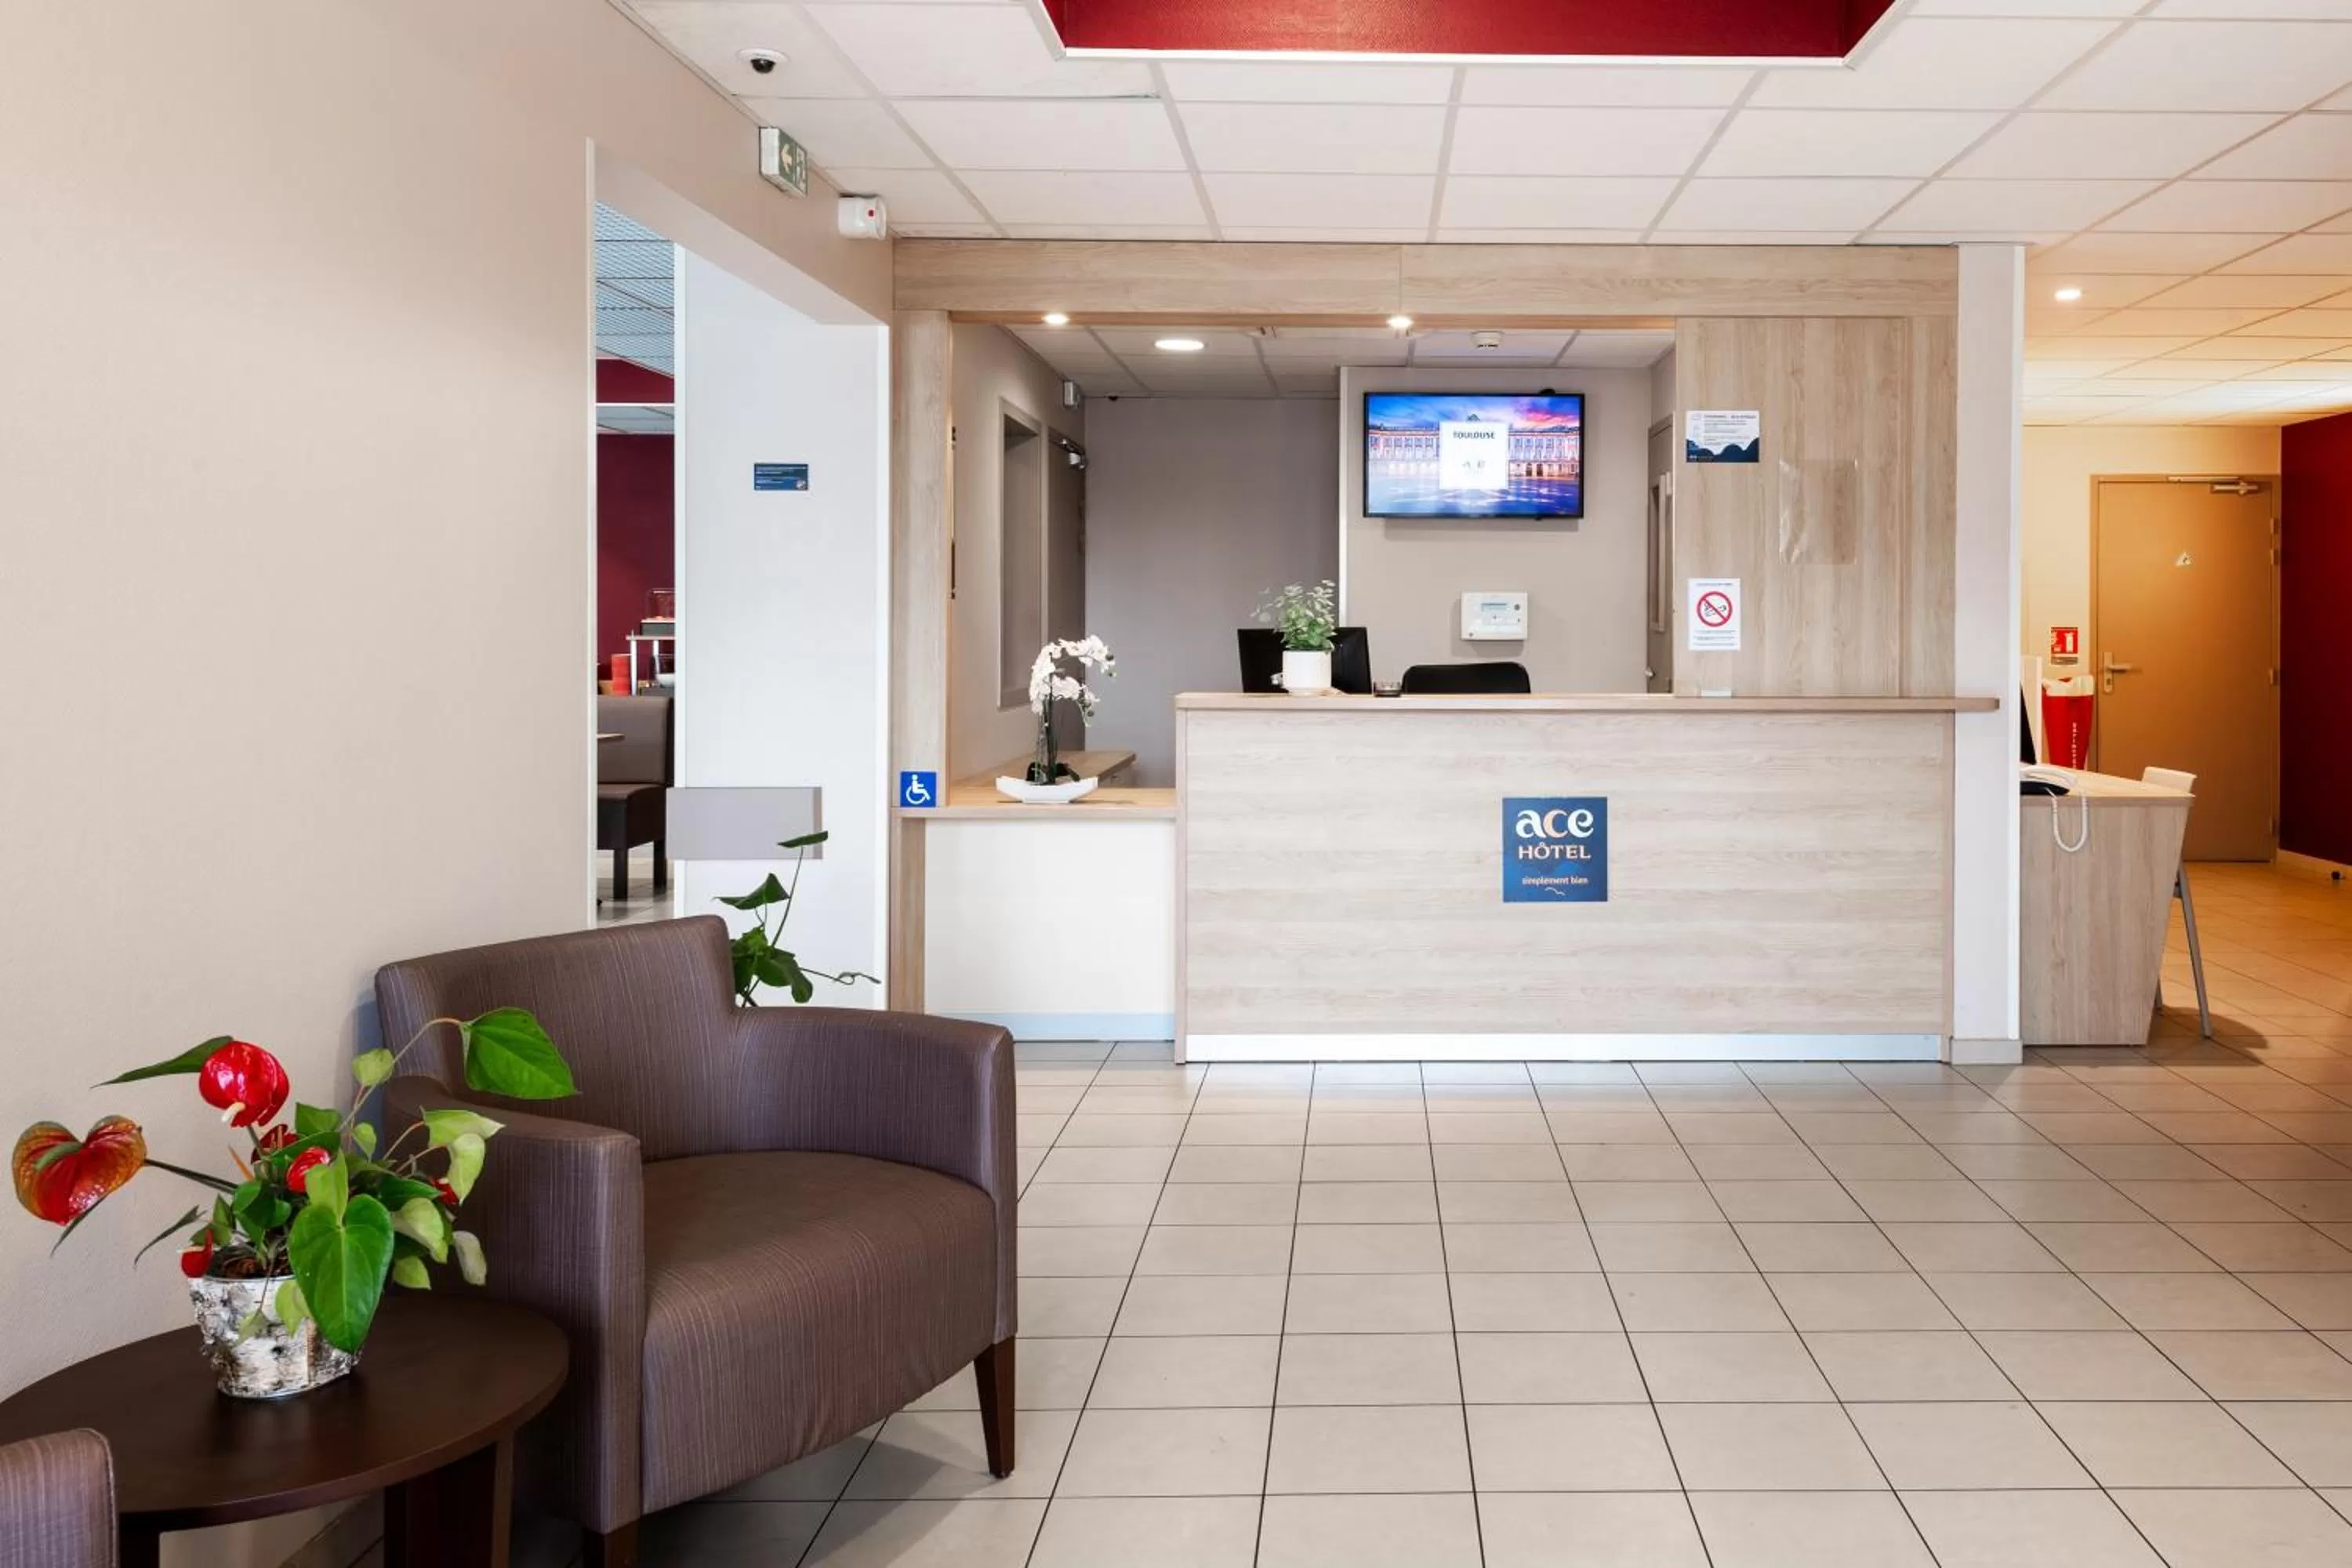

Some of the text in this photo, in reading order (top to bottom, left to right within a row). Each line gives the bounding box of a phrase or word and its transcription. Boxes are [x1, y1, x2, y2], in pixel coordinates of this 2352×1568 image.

[1453, 430, 1496, 440] TOULOUSE
[1515, 808, 1594, 838] ace
[1518, 842, 1592, 860] HÔTEL
